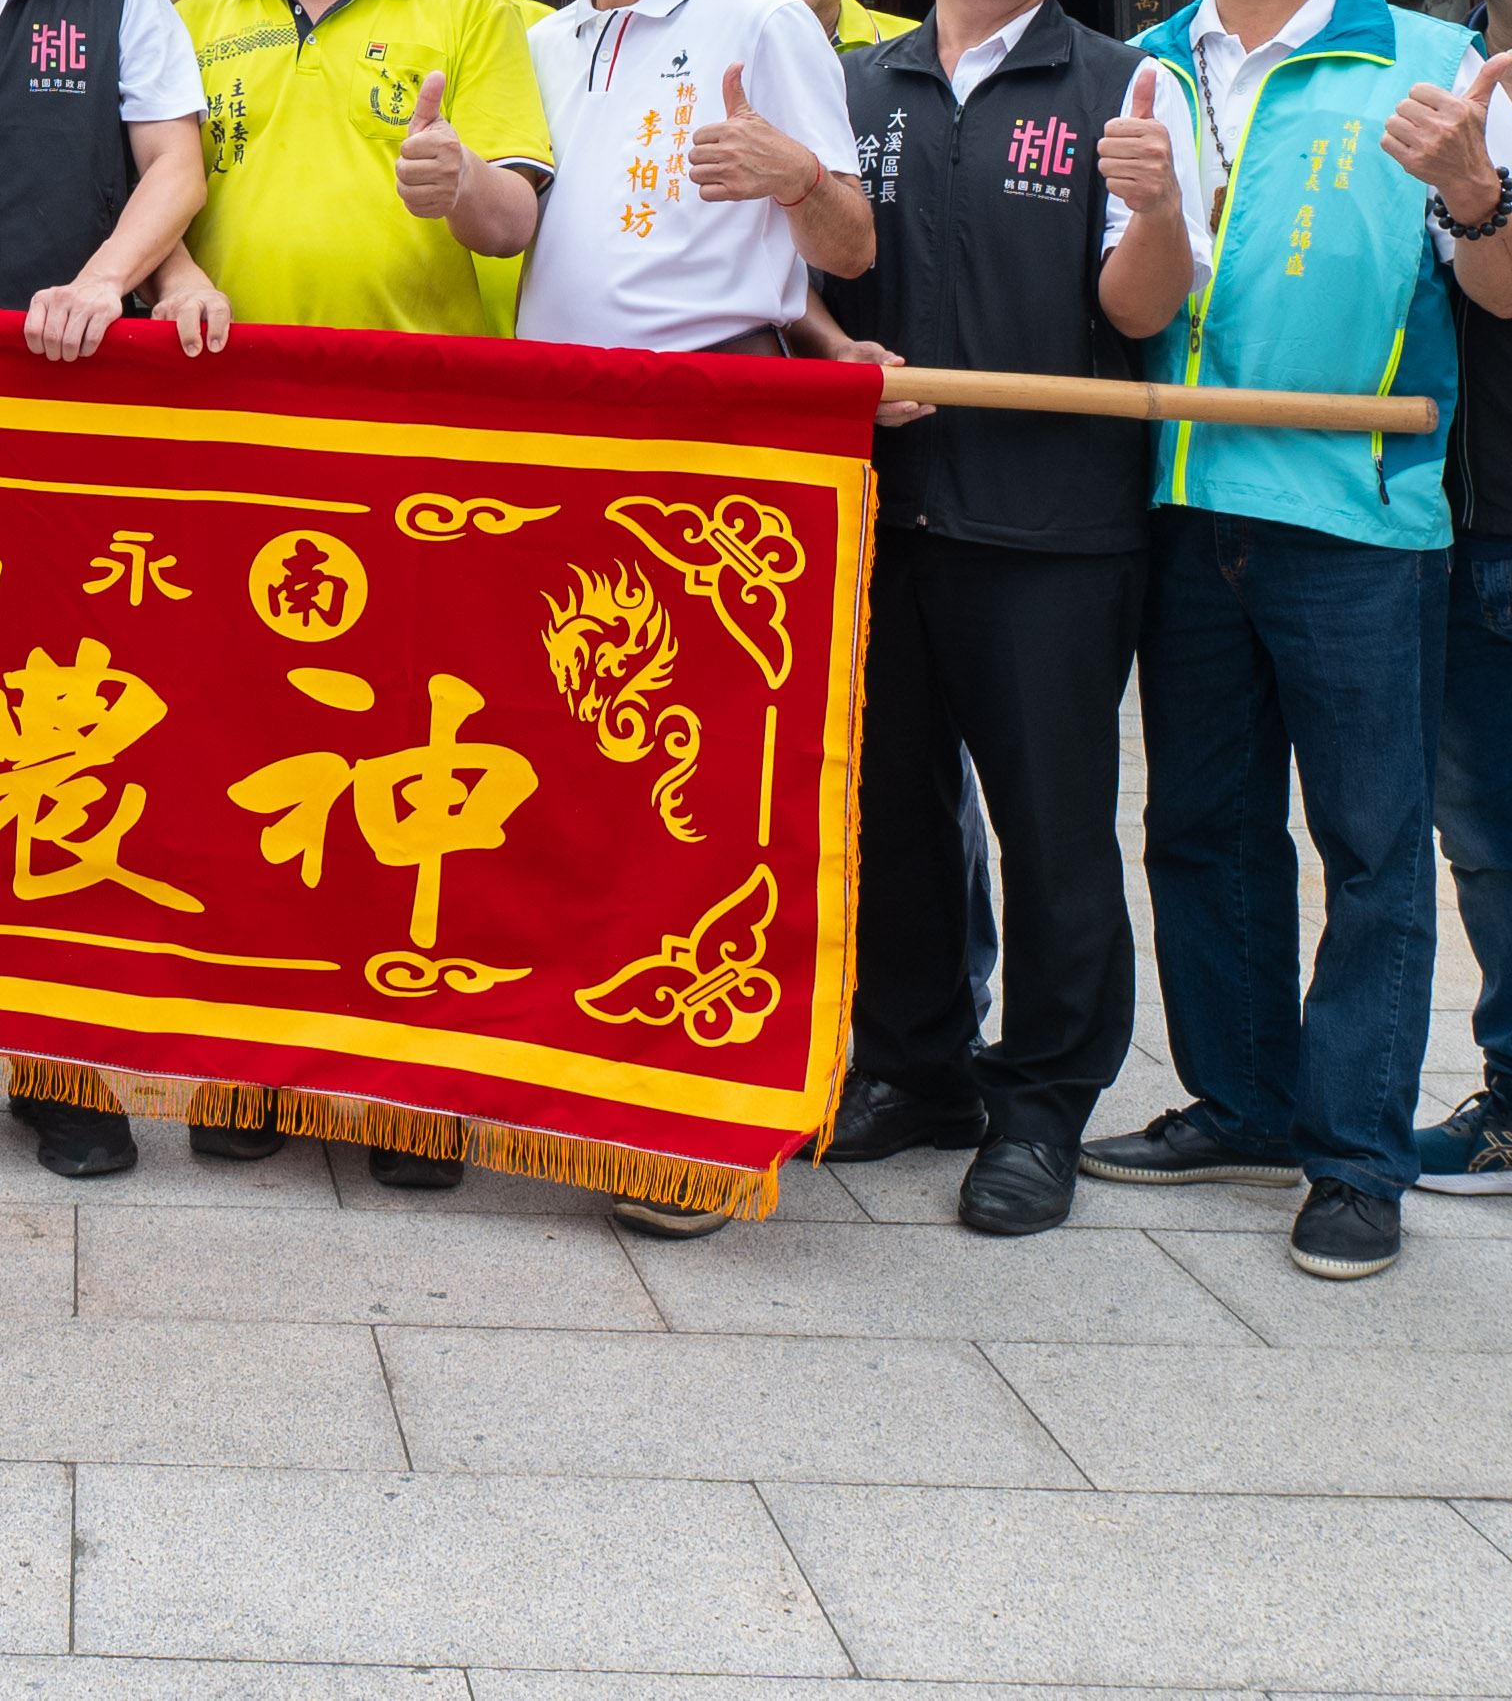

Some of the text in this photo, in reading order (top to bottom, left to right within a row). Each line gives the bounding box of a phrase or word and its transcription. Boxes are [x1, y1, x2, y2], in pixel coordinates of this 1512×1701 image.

[29, 77, 87, 90] 桃園市政府
[228, 77, 249, 166] 主任委員
[388, 80, 409, 115] 永昌宮
[620, 109, 663, 239] 李柏坊
[664, 81, 698, 203] 桃園市議員
[879, 107, 908, 204] 大溪區長
[1304, 139, 1330, 192] 理事長
[1003, 178, 1072, 199] 桃園市政府
[267, 539, 349, 625] 南
